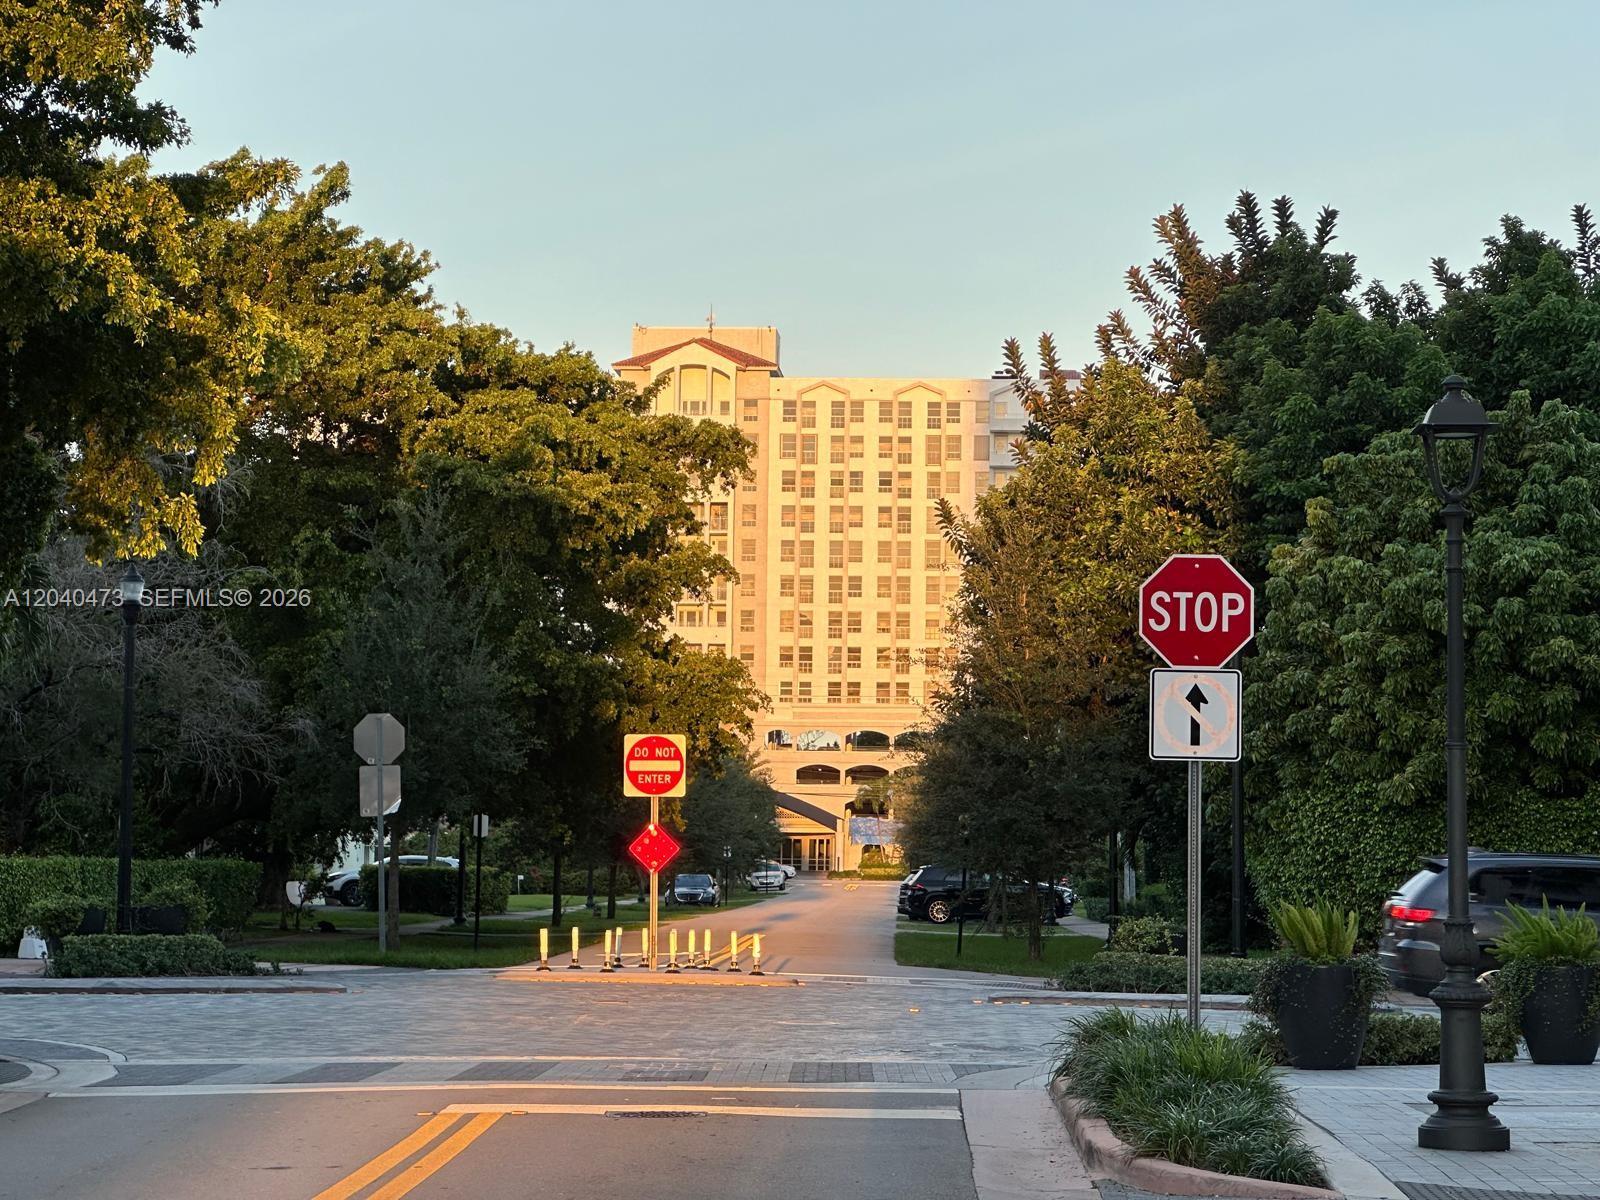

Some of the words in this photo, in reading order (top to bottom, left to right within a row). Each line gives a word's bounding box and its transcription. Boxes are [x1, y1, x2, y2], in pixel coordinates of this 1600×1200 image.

[1149, 590, 1245, 633] STOP
[634, 747, 649, 758] DO
[655, 747, 676, 758] NOT
[638, 774, 671, 784] ENTER
